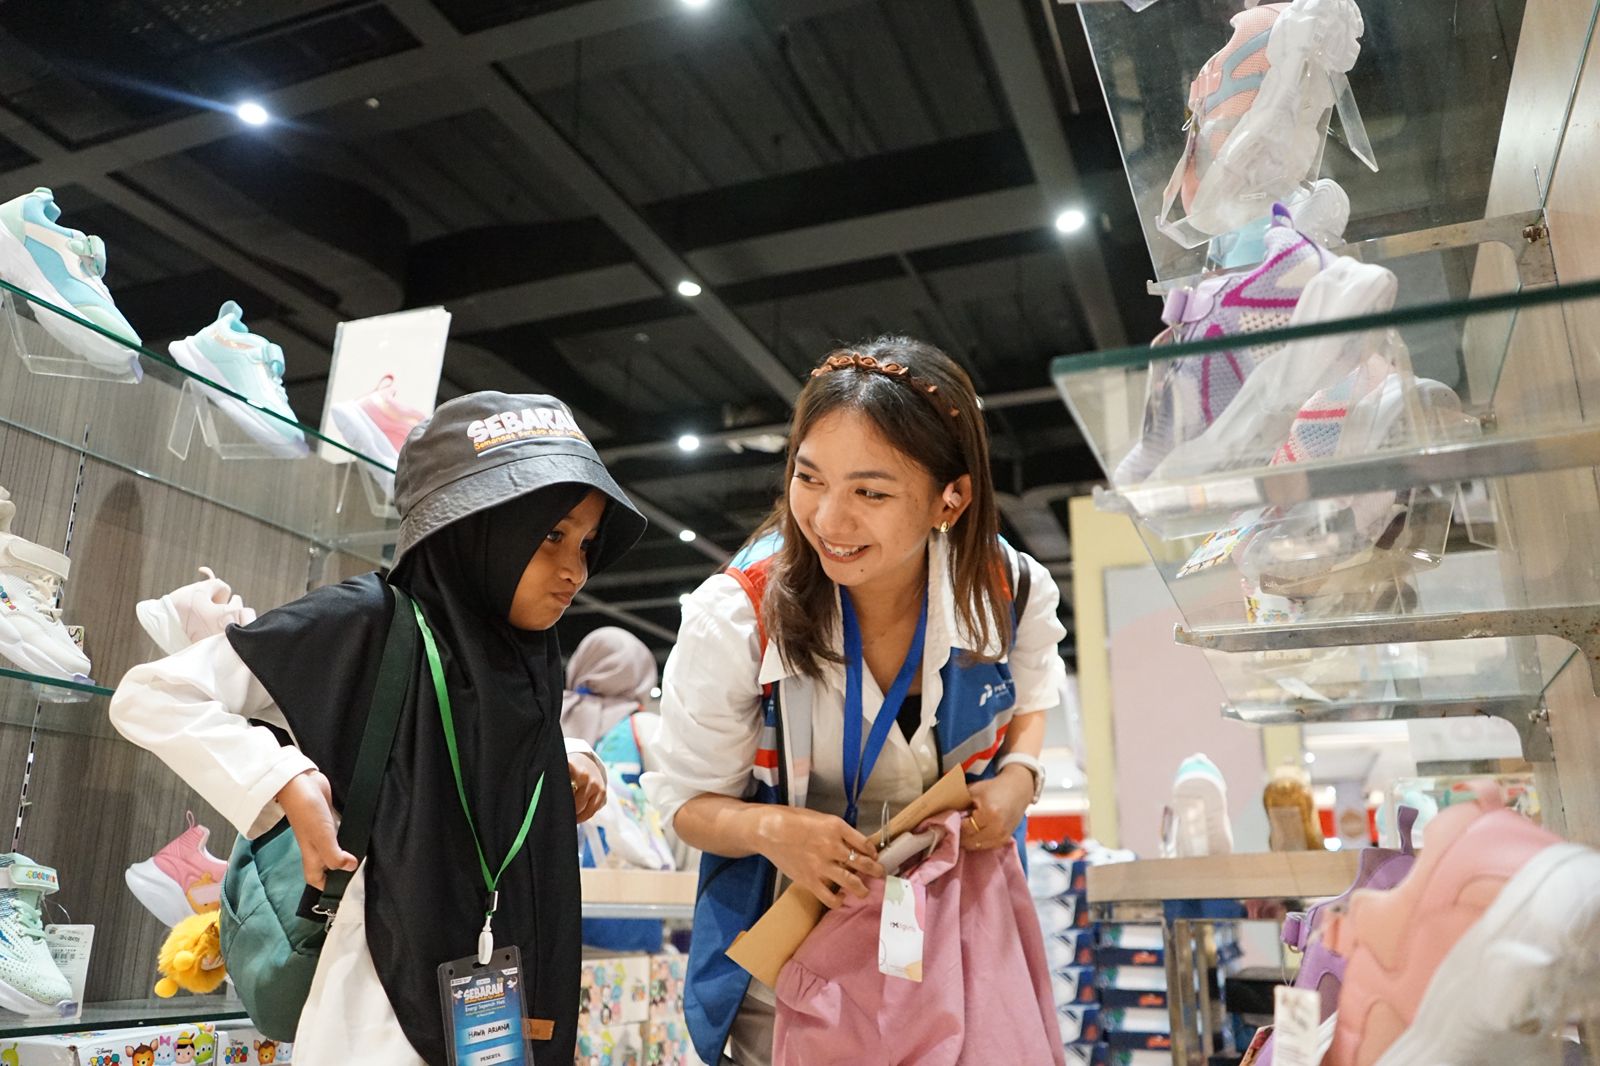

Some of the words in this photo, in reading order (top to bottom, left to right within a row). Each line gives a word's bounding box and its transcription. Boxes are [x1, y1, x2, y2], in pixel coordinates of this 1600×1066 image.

[463, 983, 504, 999] SEBARAN
[468, 1030, 486, 1039] HAWA
[488, 1023, 510, 1033] ARIANA
[94, 1047, 113, 1055] Disney
